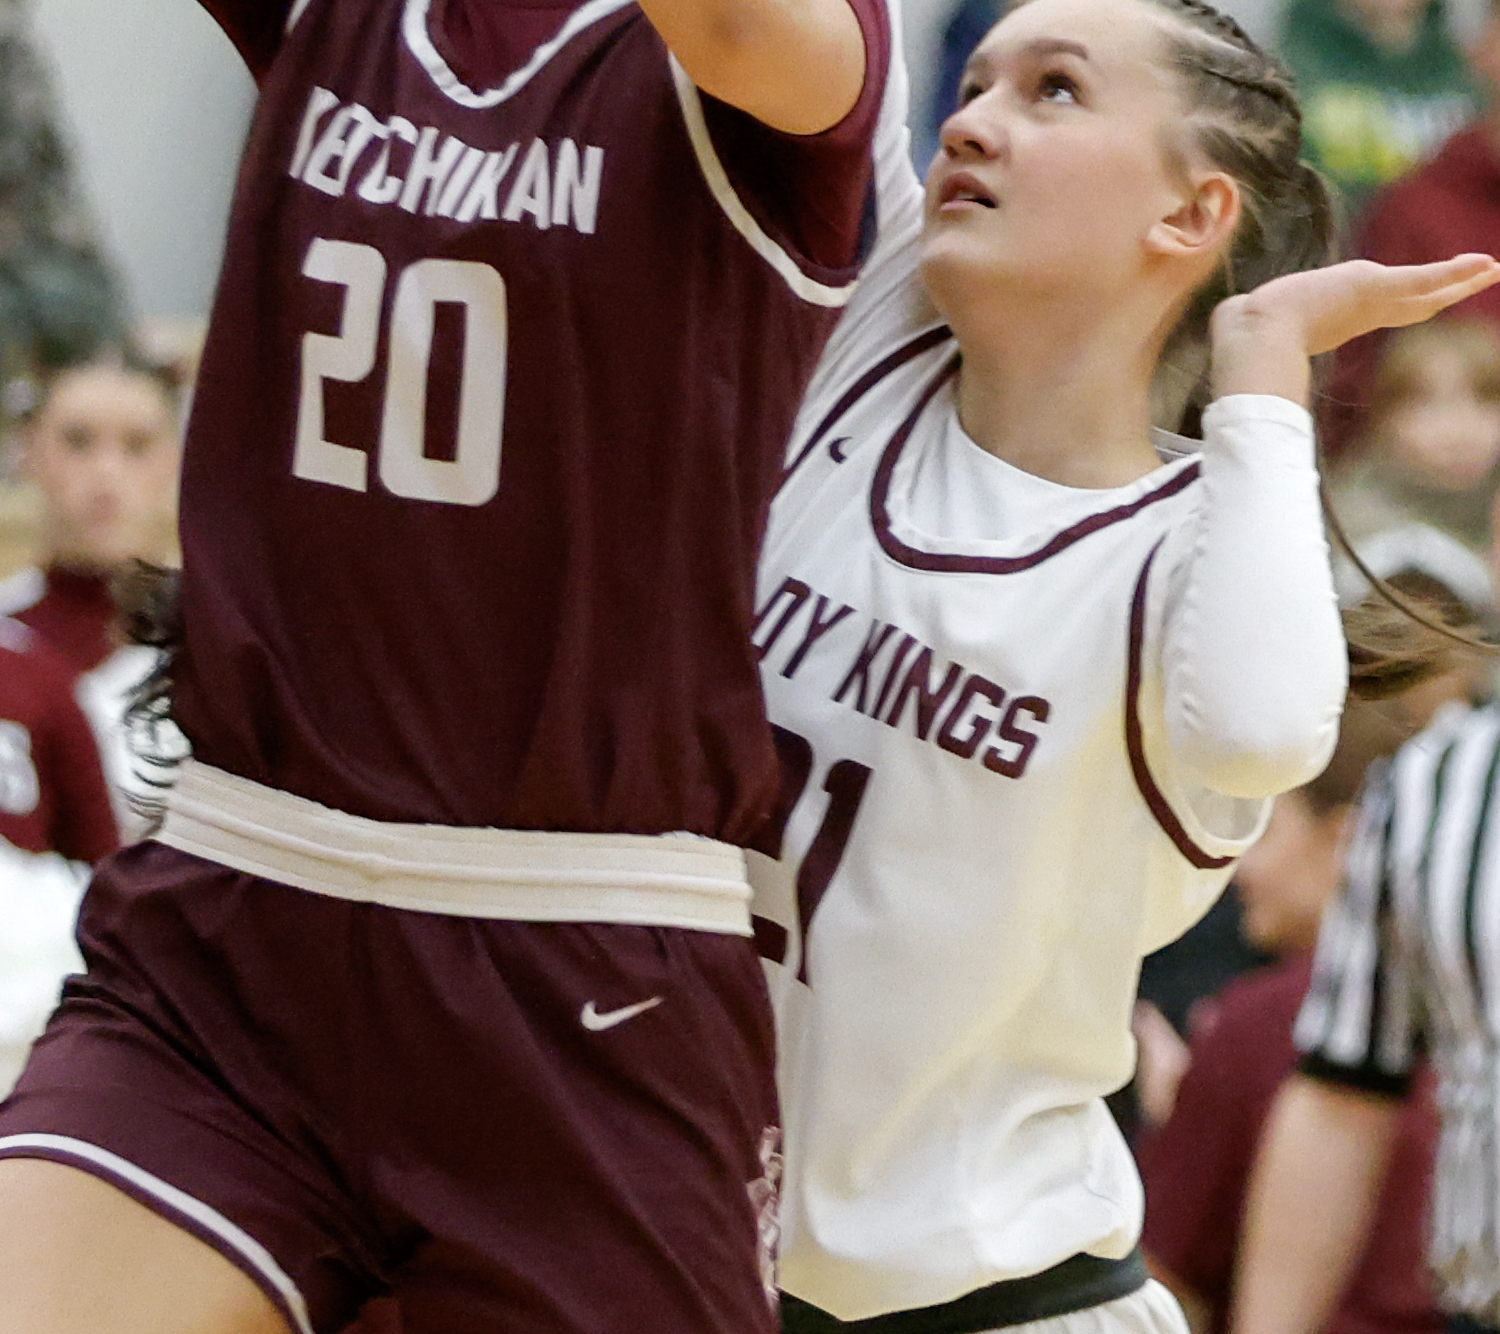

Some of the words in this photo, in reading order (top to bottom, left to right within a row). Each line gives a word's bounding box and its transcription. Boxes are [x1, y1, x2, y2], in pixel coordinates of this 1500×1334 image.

[292, 237, 508, 506] 20
[751, 576, 857, 679] DY
[831, 618, 1051, 779] KINGS
